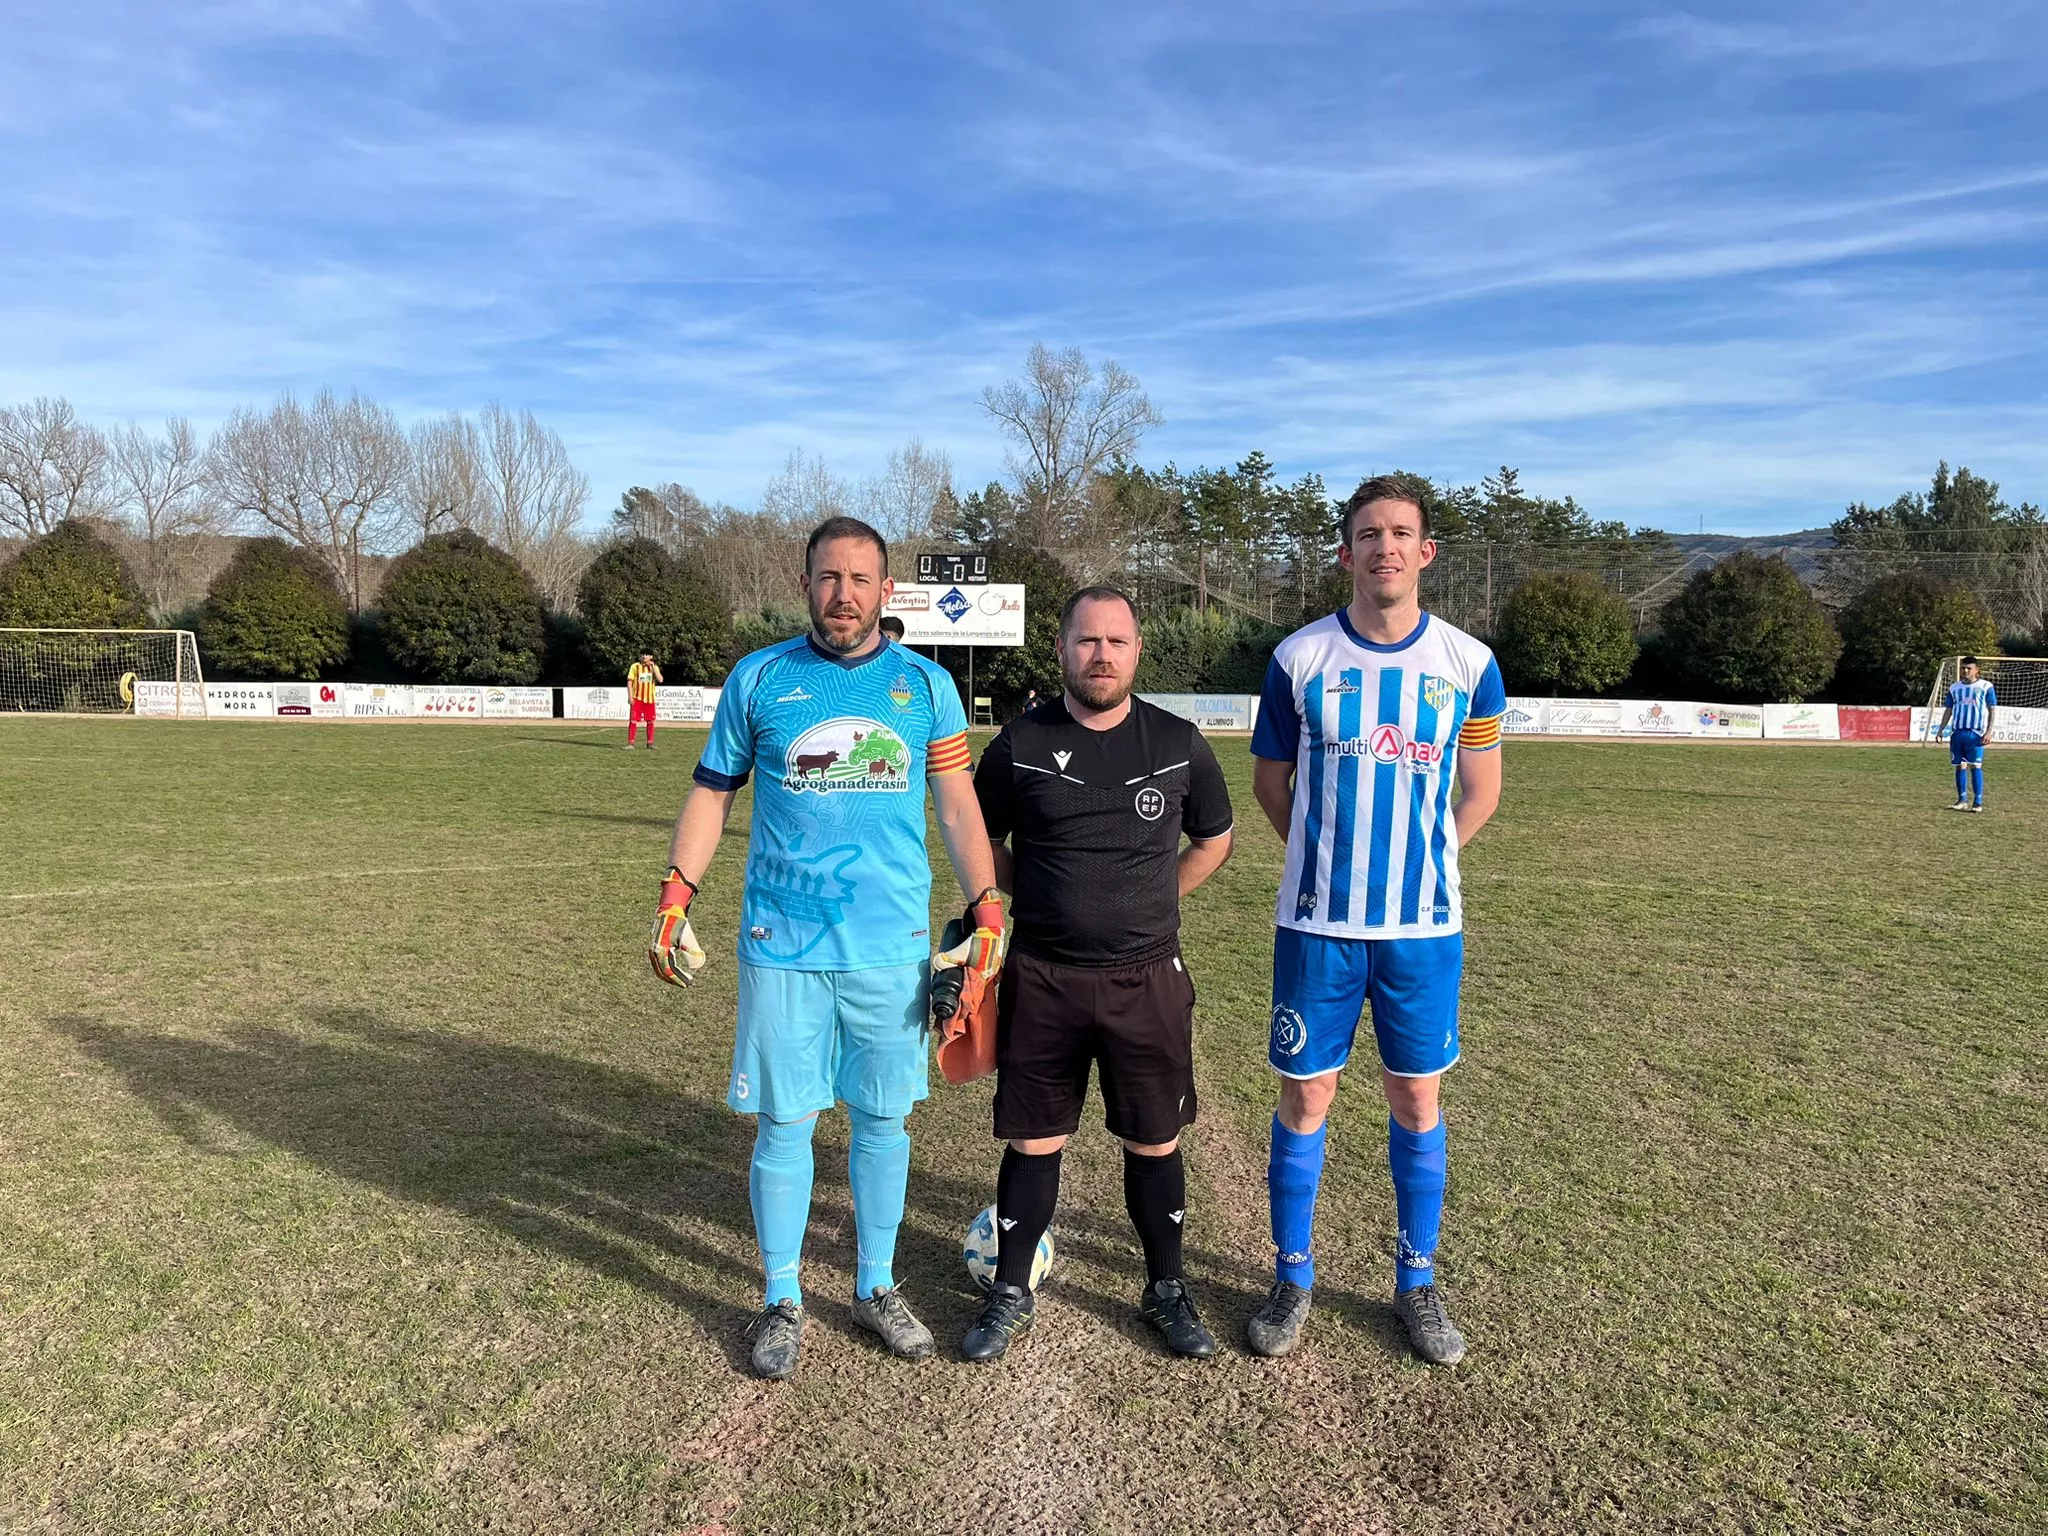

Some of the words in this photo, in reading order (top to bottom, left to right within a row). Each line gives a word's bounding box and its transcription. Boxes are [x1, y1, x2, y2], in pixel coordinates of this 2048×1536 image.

[208, 691, 272, 699] HIDROGAS
[777, 694, 814, 703] MERCURY
[224, 702, 257, 710] MORA
[1719, 709, 1760, 720] Promesas
[1327, 739, 1368, 755] multi
[1405, 741, 1442, 762] nau
[784, 777, 907, 792] Agroganaderasin
